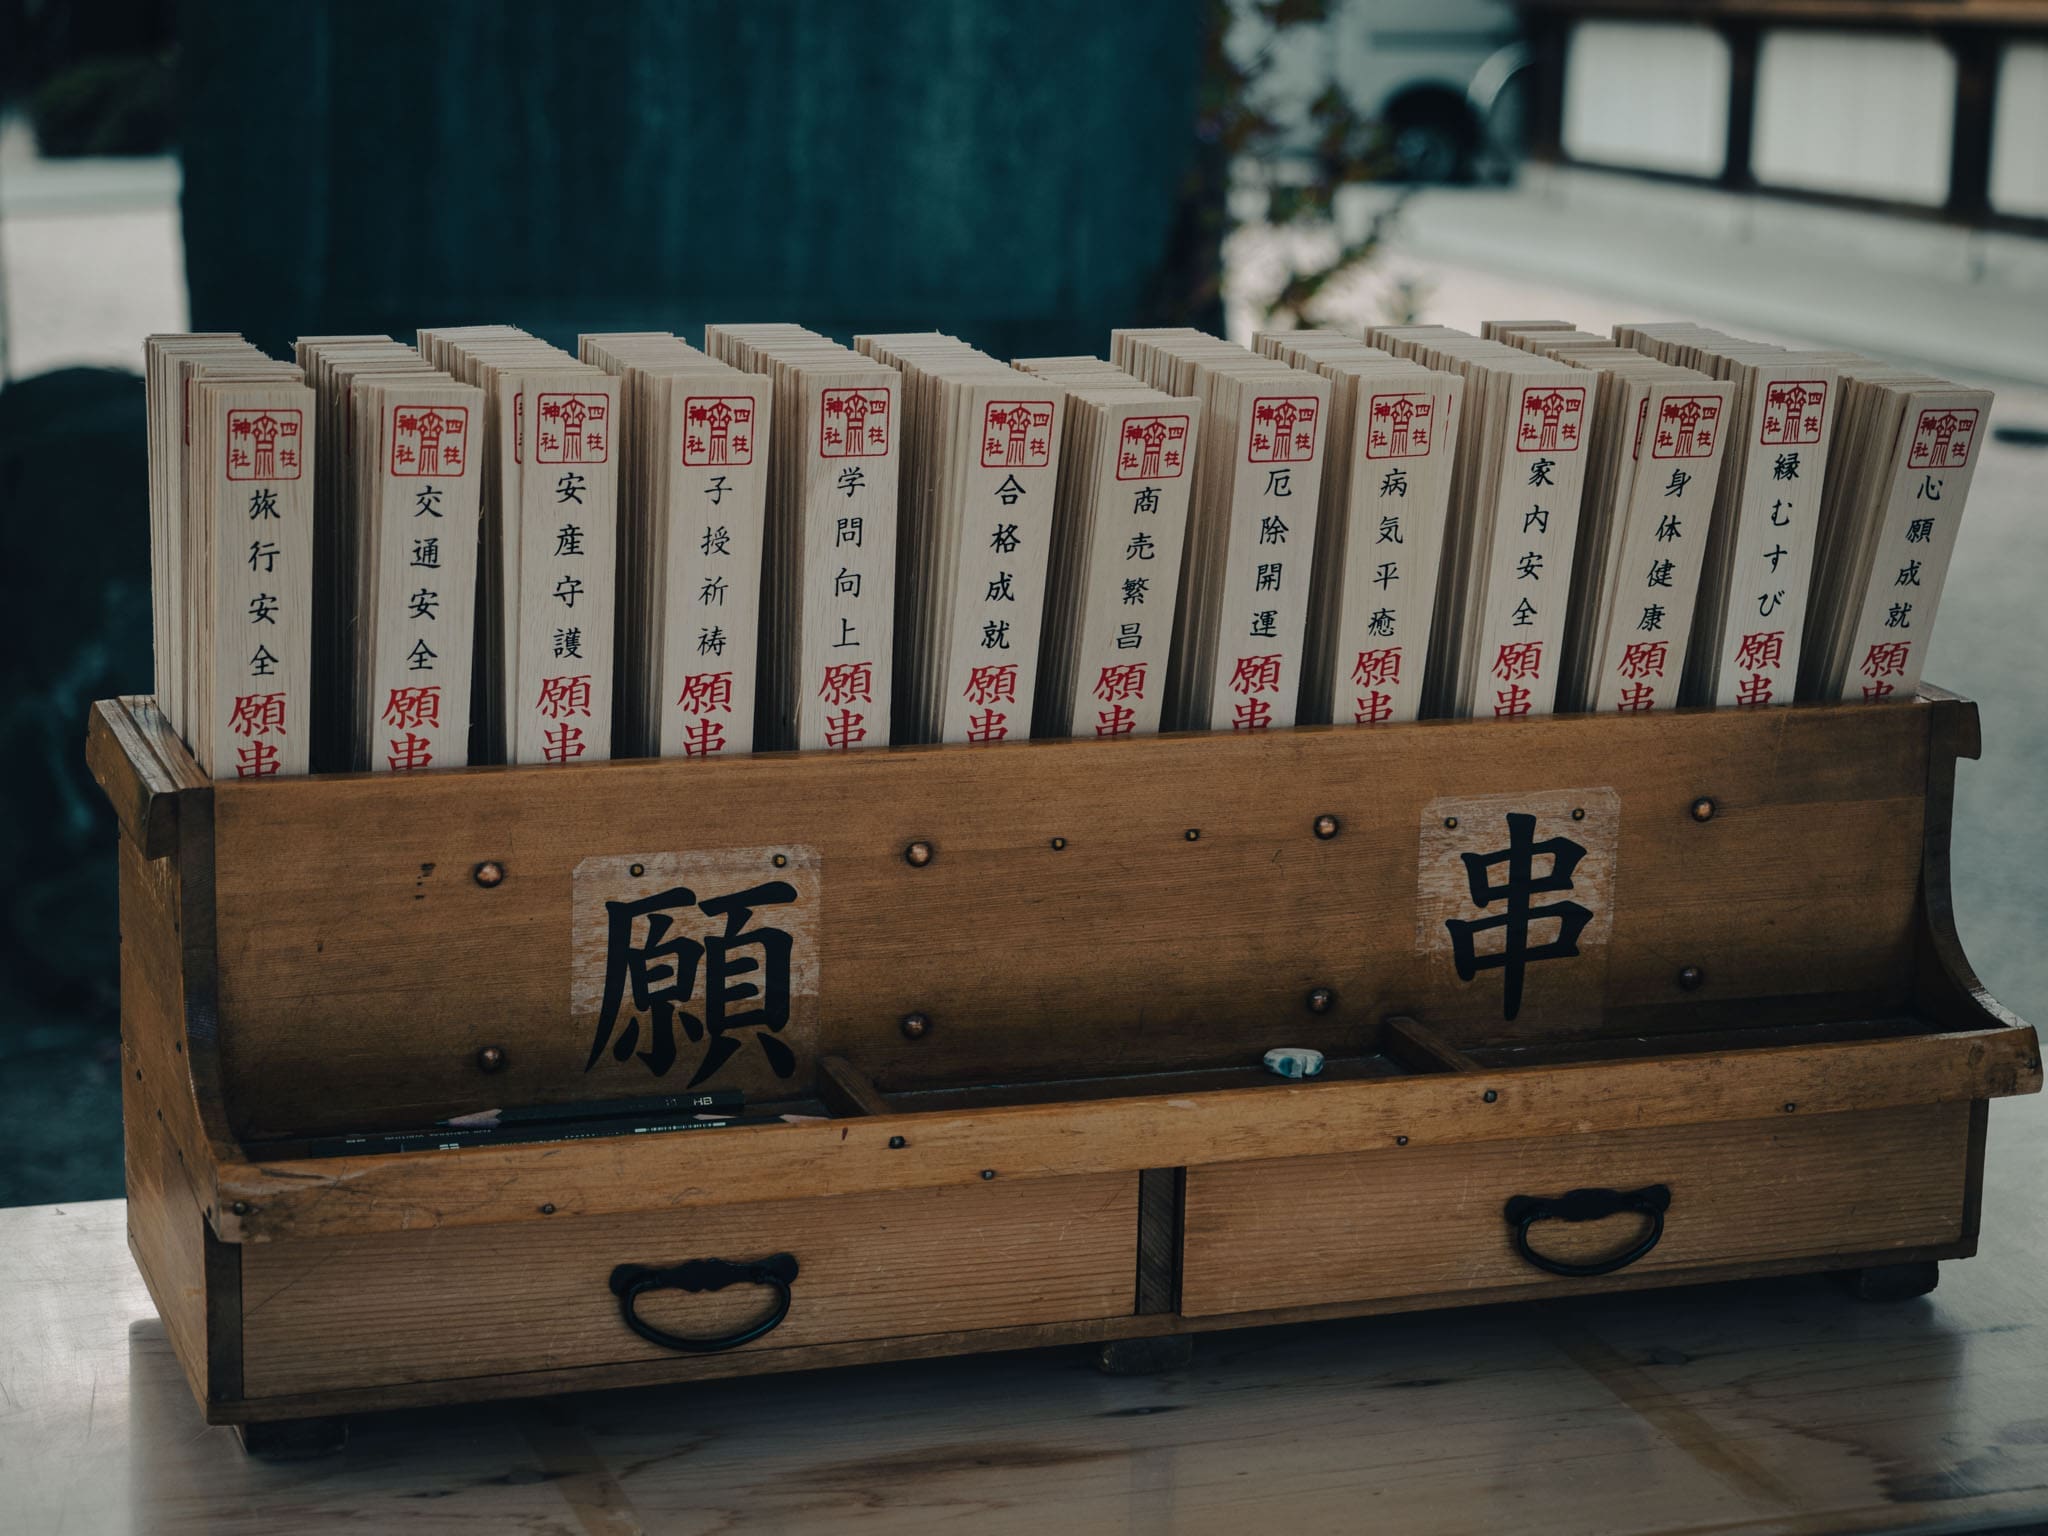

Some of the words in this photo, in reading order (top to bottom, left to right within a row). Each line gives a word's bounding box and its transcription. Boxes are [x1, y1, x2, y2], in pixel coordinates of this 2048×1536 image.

[248, 489, 280, 676] 旅行安全
[407, 485, 442, 670] 交通安全
[553, 472, 586, 658] 安産守護
[698, 477, 732, 656] 子授祈祷
[833, 467, 865, 647] 学問向上
[981, 474, 1025, 649] 合格成就
[1117, 487, 1161, 649] 商売繁昌
[1250, 469, 1291, 637] 厄除開運
[1368, 468, 1407, 636] 病気平癒
[1512, 458, 1555, 626] 家内安全
[1637, 469, 1694, 633] 身体健康
[1758, 453, 1800, 616] 縁むすび
[1885, 475, 1943, 628] 心願成就
[584, 881, 797, 1089] 願
[1445, 812, 1594, 1021] 串
